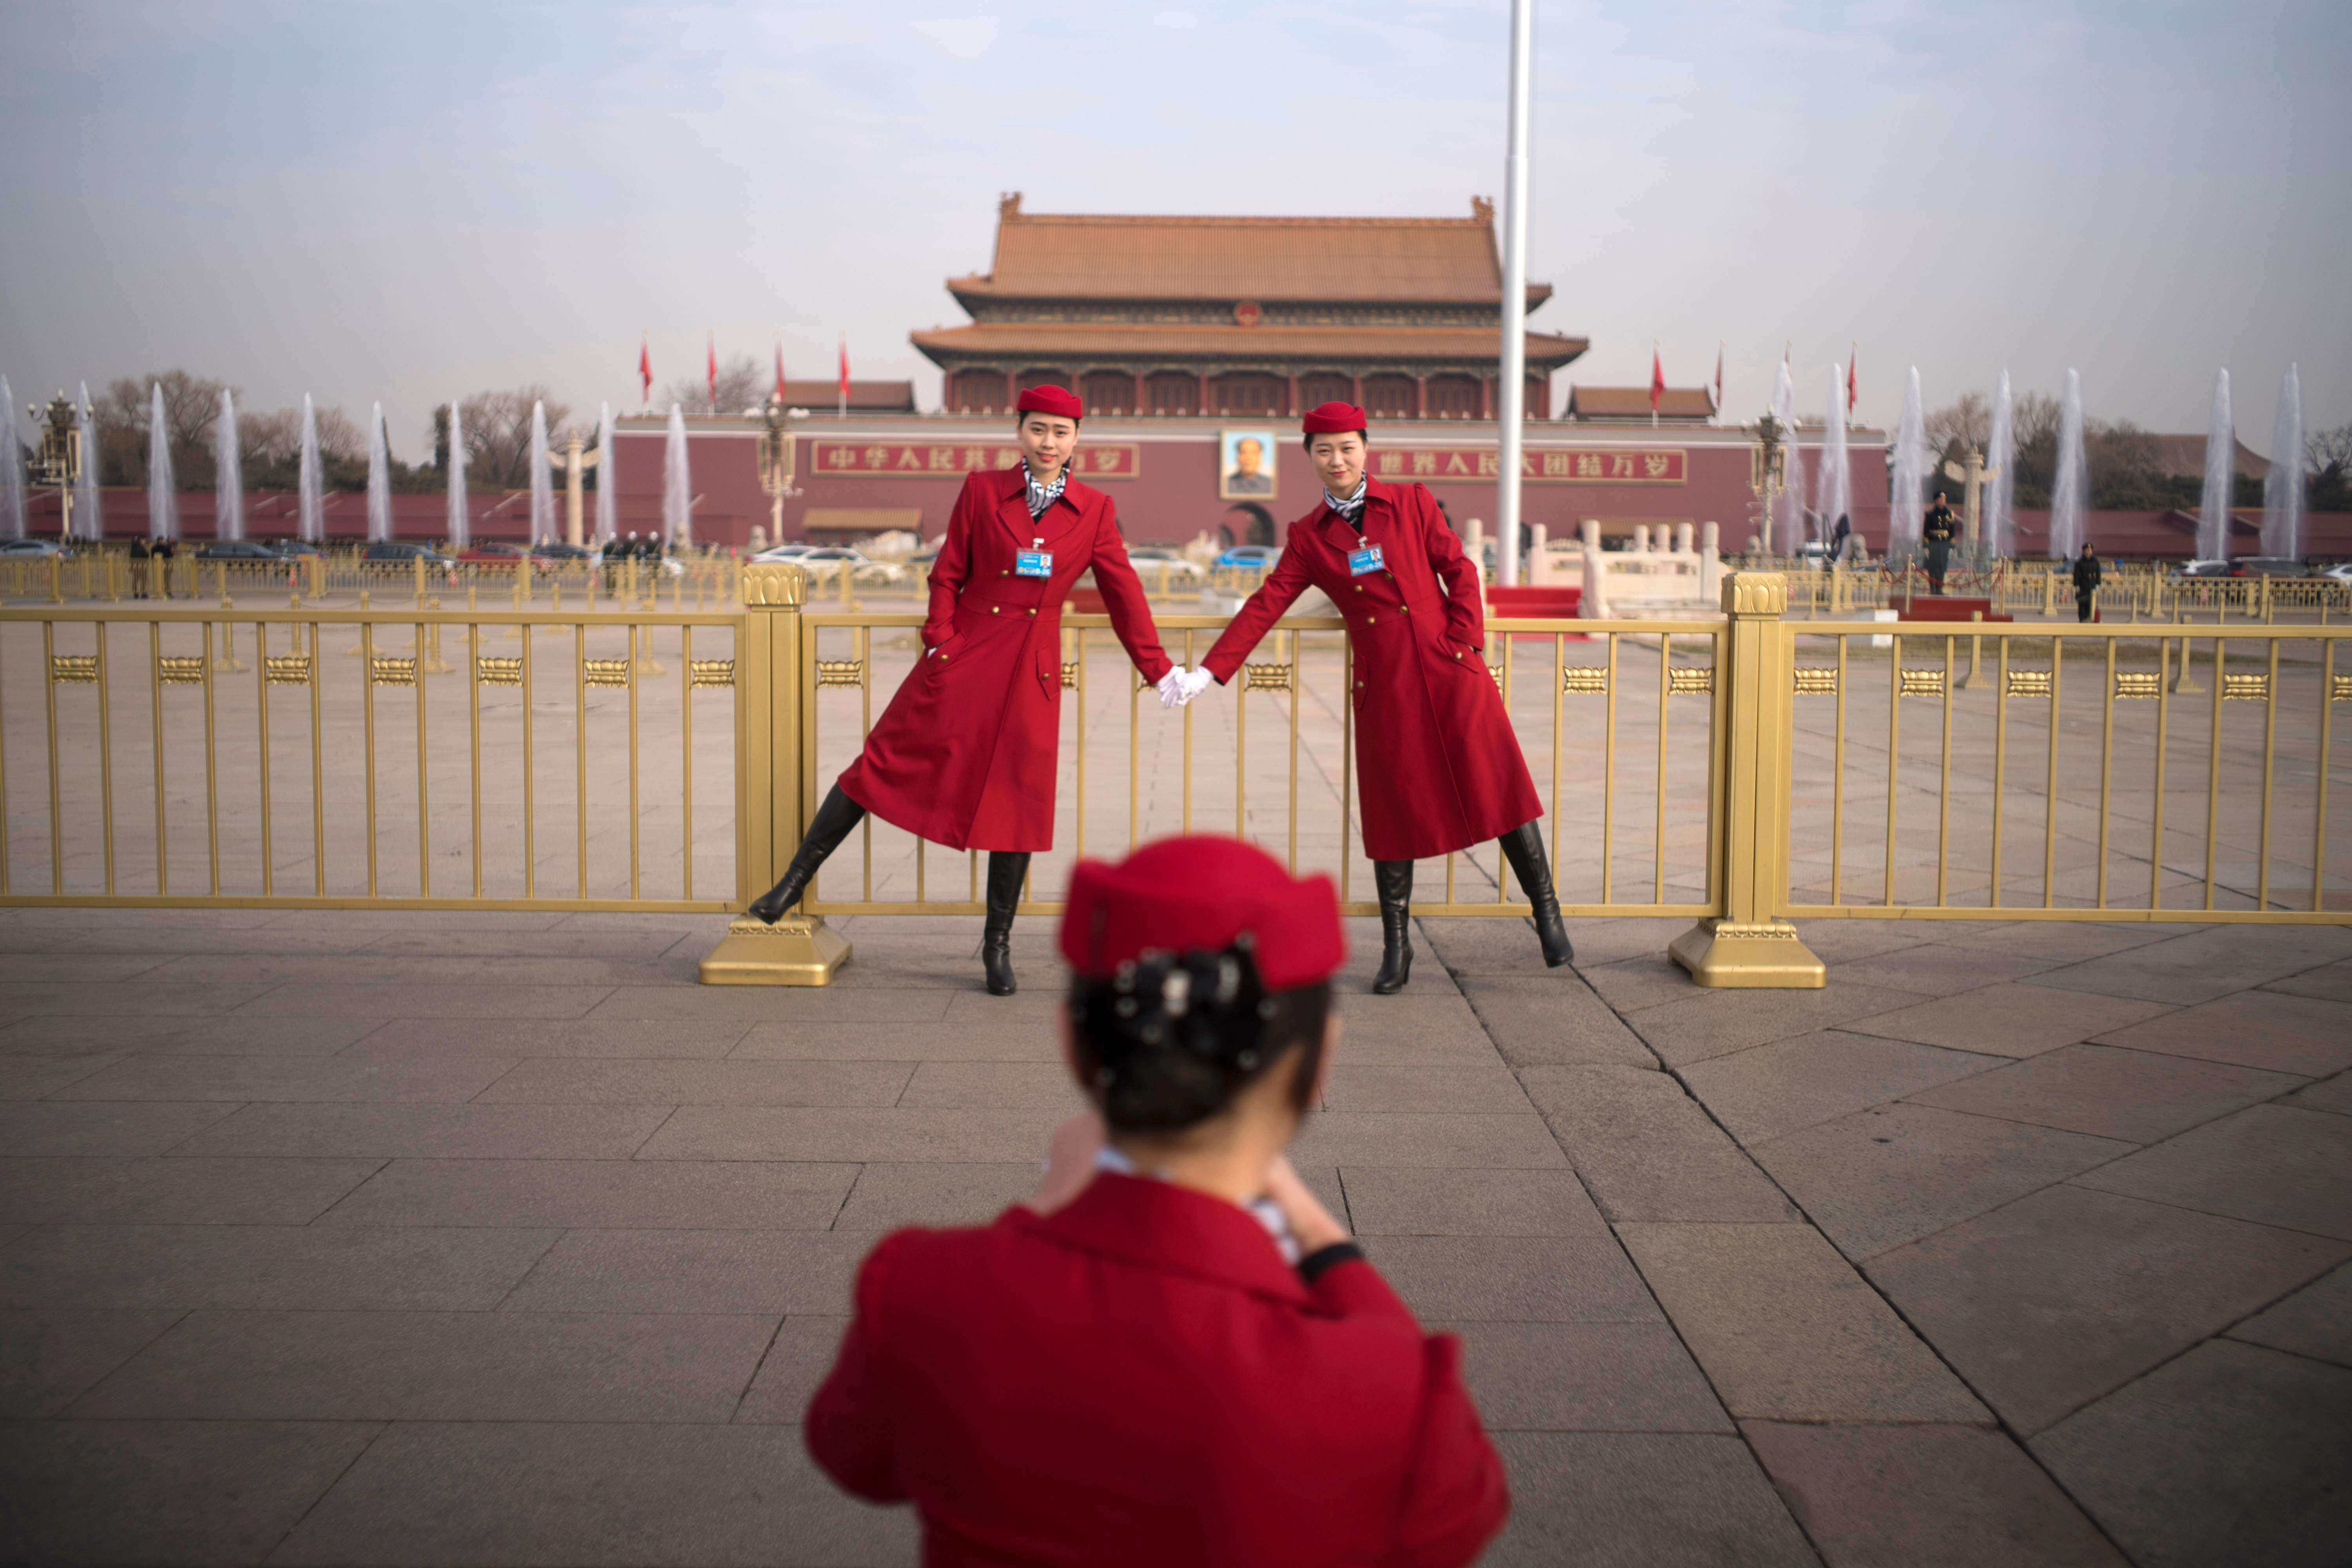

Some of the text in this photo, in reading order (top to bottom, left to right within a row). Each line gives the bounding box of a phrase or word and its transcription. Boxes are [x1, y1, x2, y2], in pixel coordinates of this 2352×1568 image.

[829, 446, 1120, 471] 中华人民共和岁
